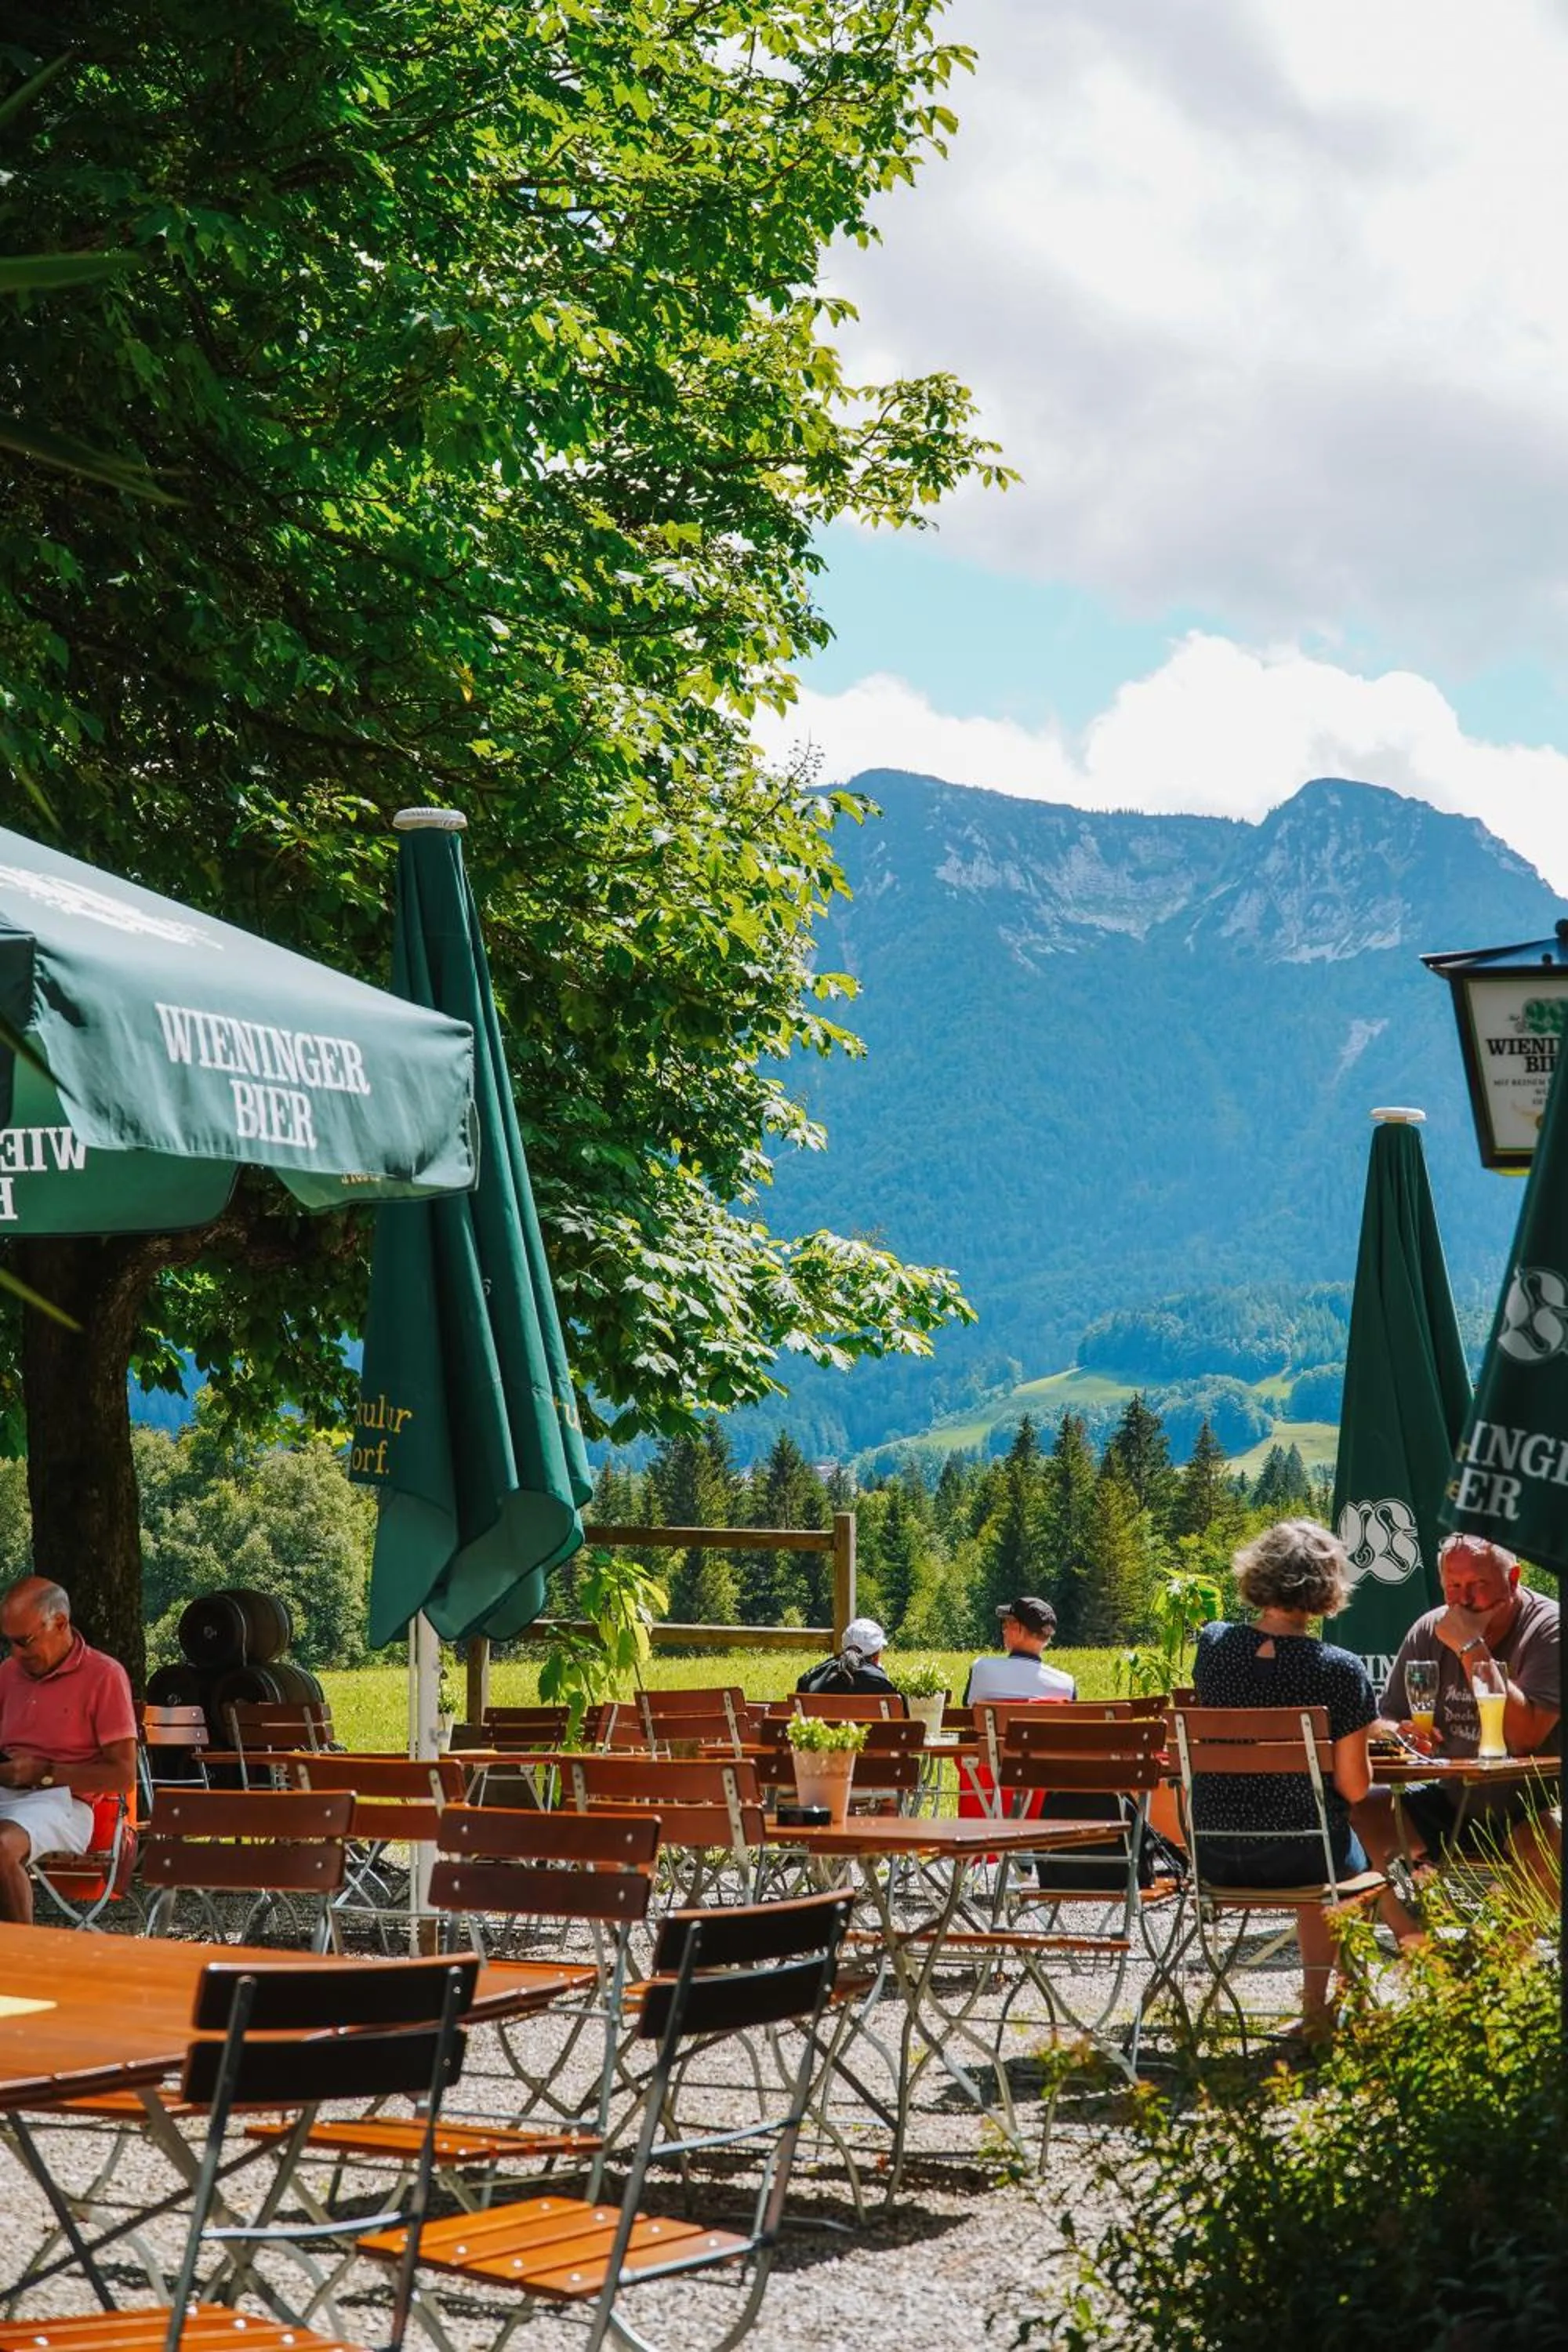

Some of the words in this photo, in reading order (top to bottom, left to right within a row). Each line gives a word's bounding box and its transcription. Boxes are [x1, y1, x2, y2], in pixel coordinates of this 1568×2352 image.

[155, 1002, 370, 1094] WIENINGER
[1486, 1037, 1559, 1055] WIENI
[229, 1079, 317, 1149] BIER
